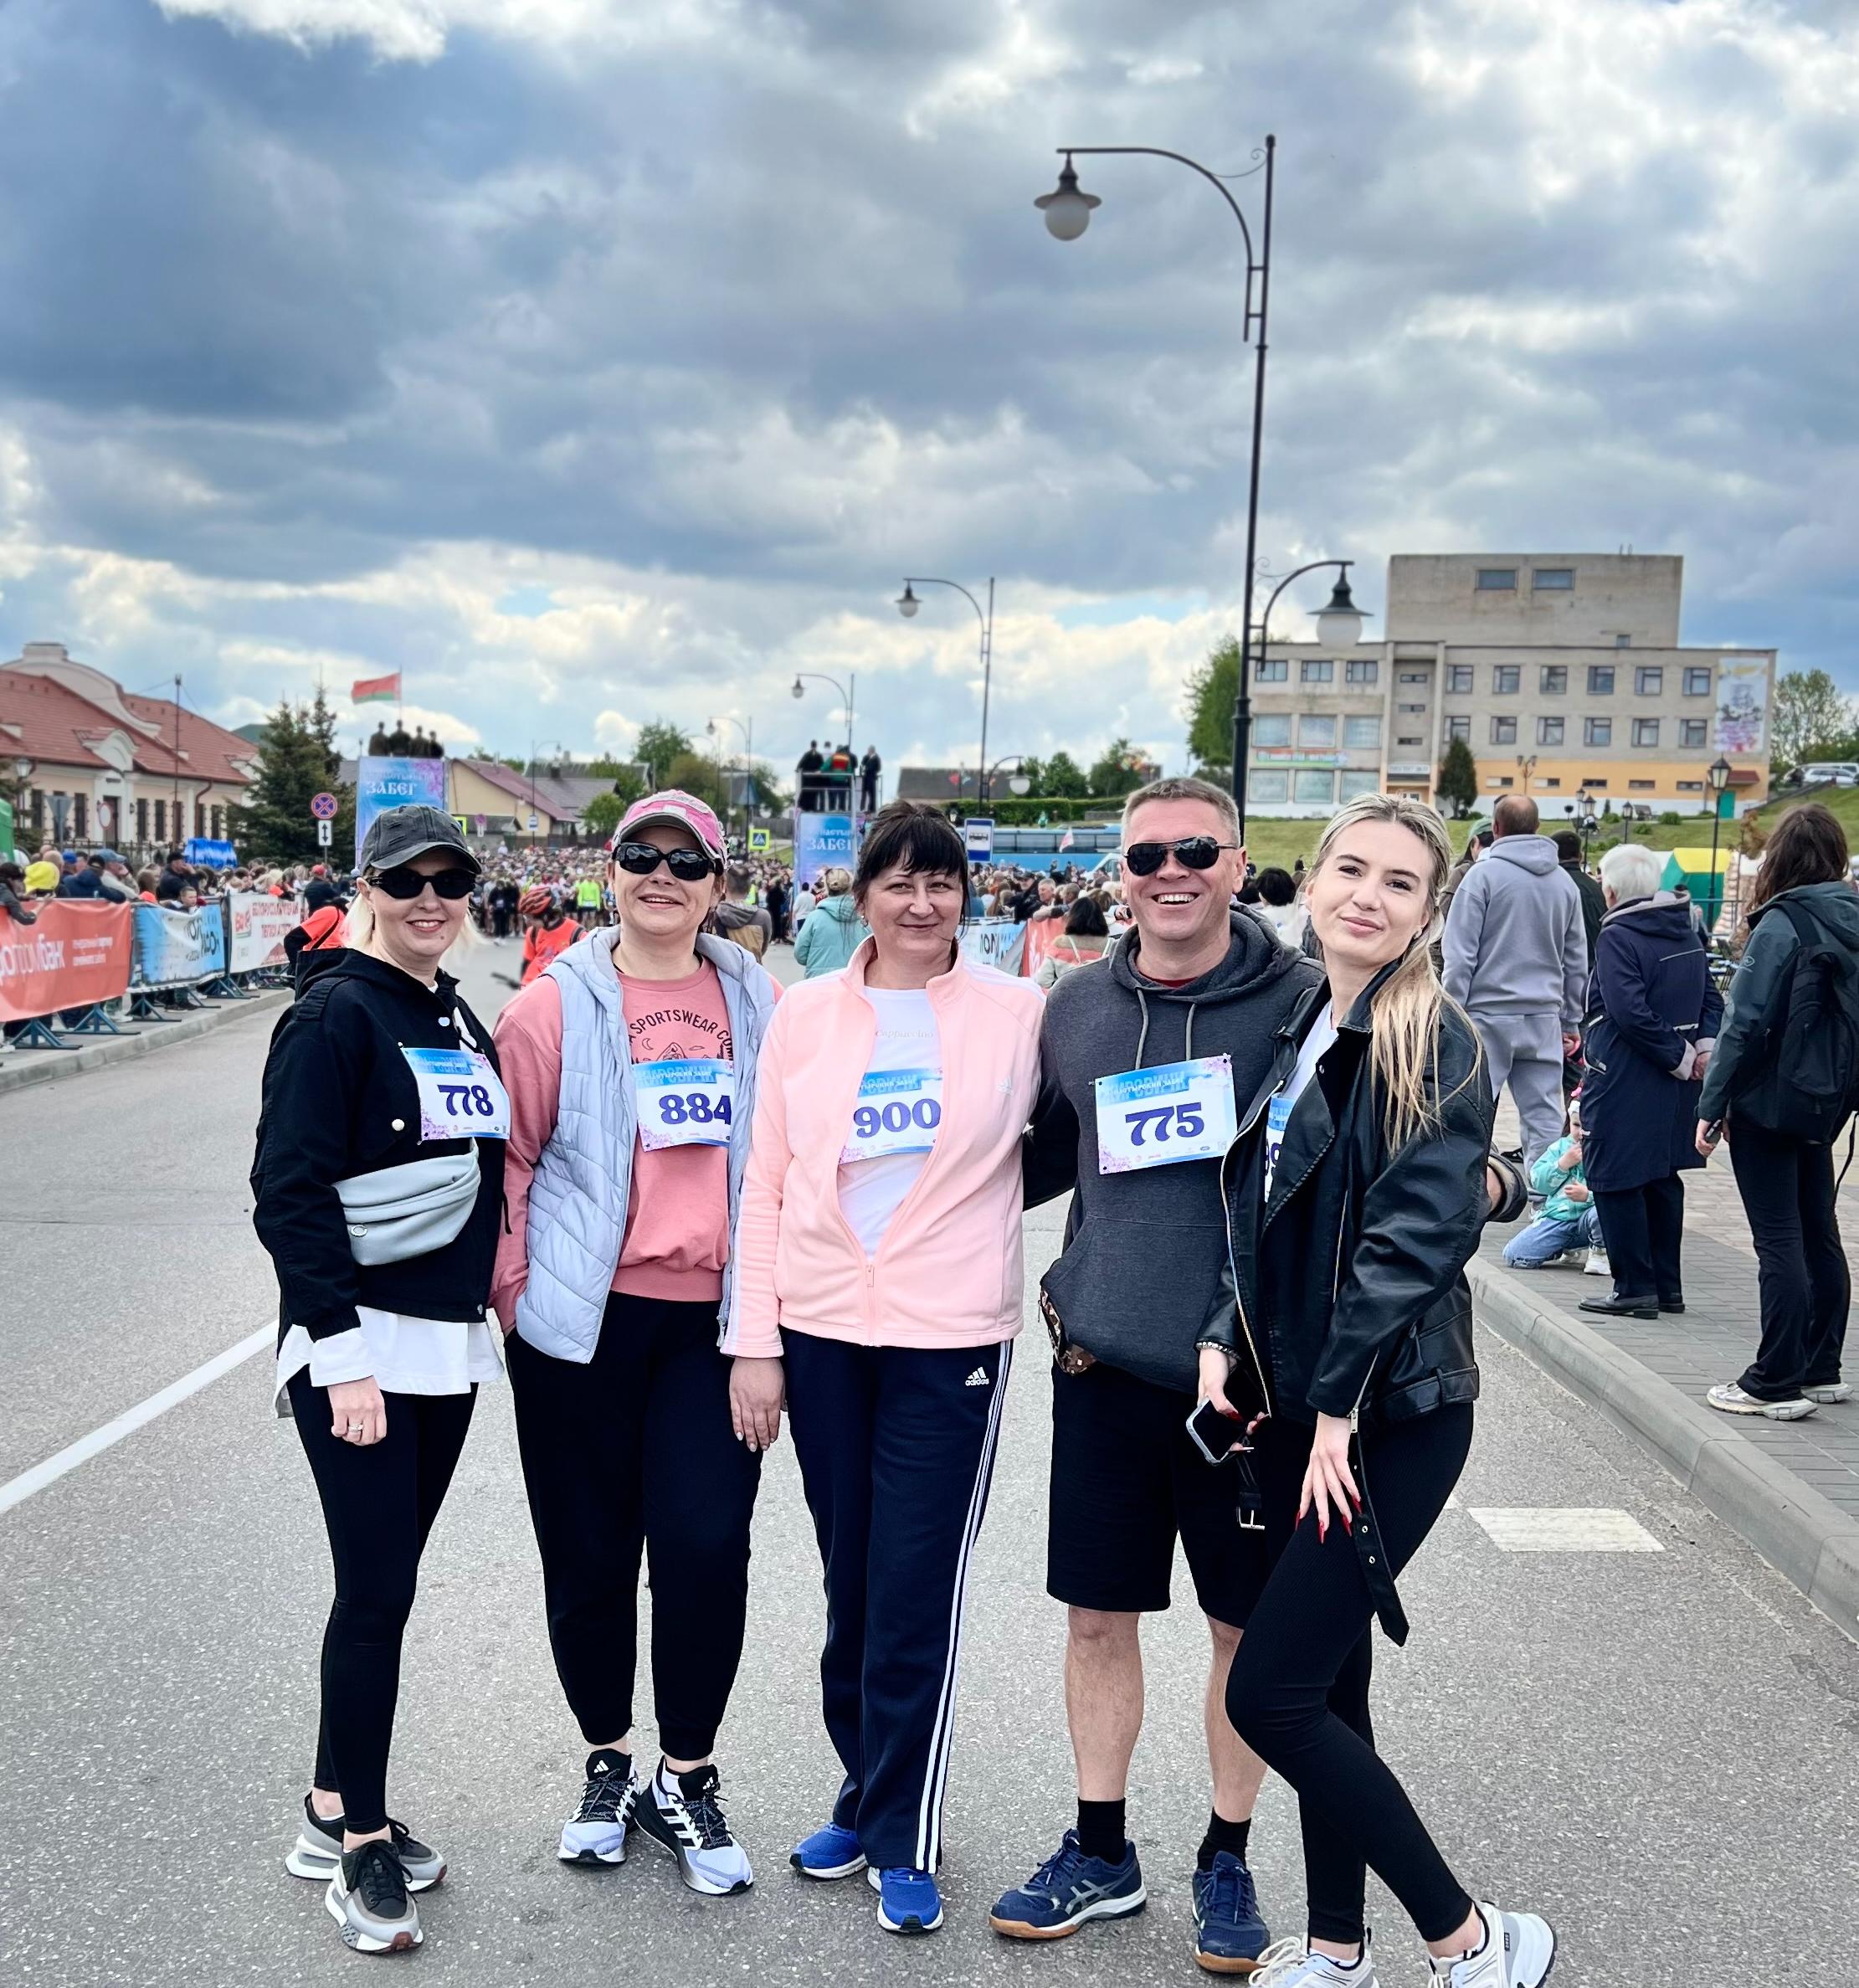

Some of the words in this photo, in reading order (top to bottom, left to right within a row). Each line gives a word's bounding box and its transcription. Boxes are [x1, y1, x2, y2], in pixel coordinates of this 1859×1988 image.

[629, 1009, 718, 1035] SPORTSWEAR
[437, 1085, 494, 1117] 778
[659, 1093, 732, 1125] 884
[854, 1098, 942, 1138] 900
[1125, 1102, 1204, 1147] 775
